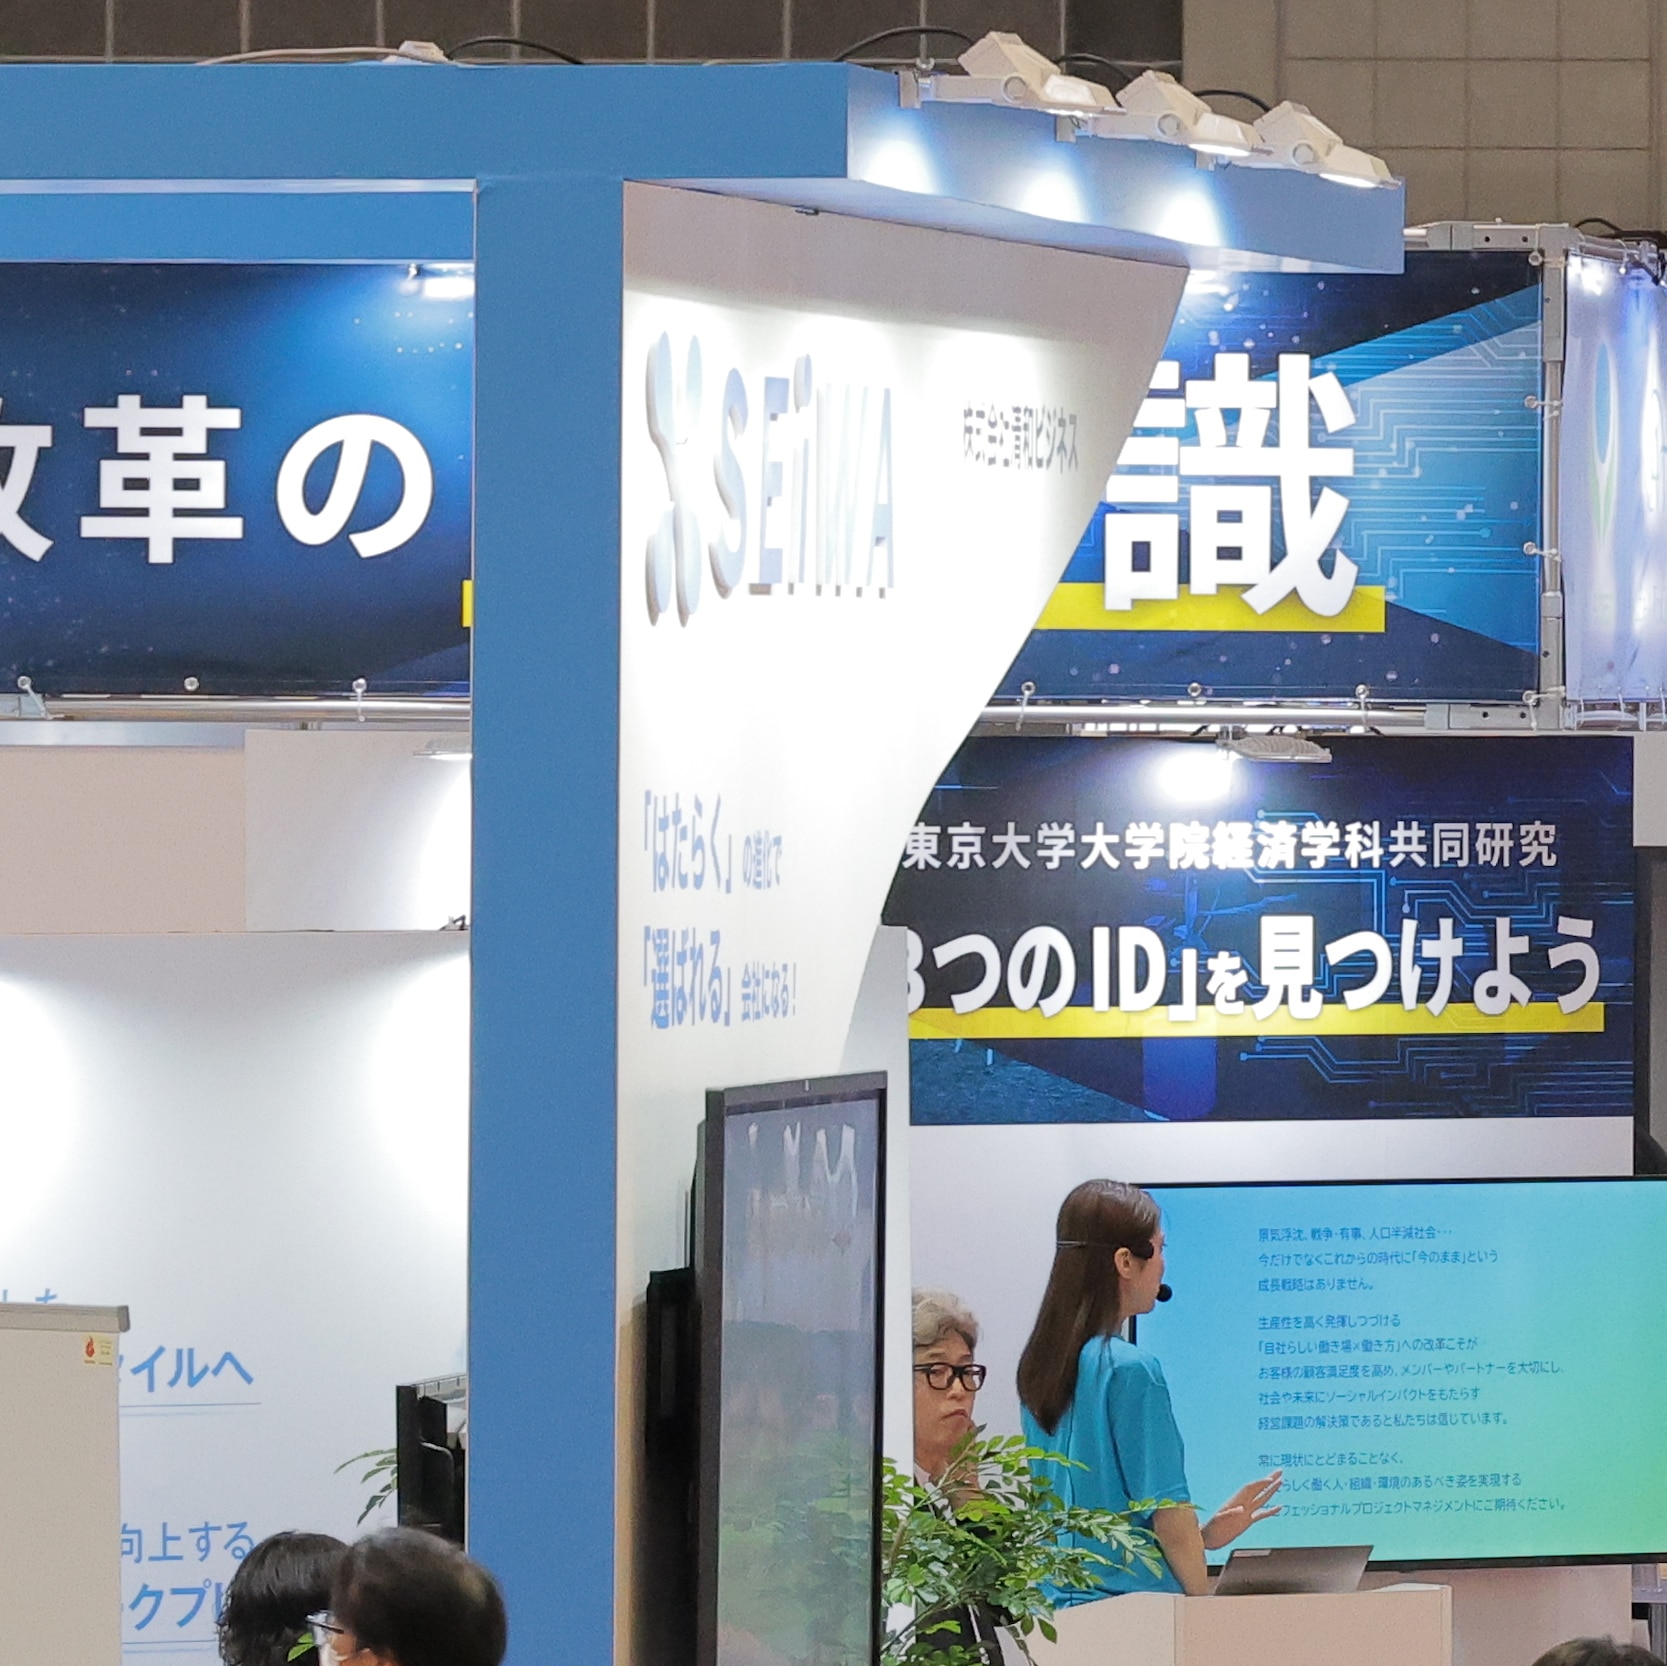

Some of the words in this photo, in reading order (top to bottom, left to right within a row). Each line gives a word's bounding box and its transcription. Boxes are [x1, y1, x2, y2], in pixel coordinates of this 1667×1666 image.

[1104, 353, 1358, 617] 識
[119, 1345, 255, 1393] イルへ
[122, 1579, 226, 1631] クプ
